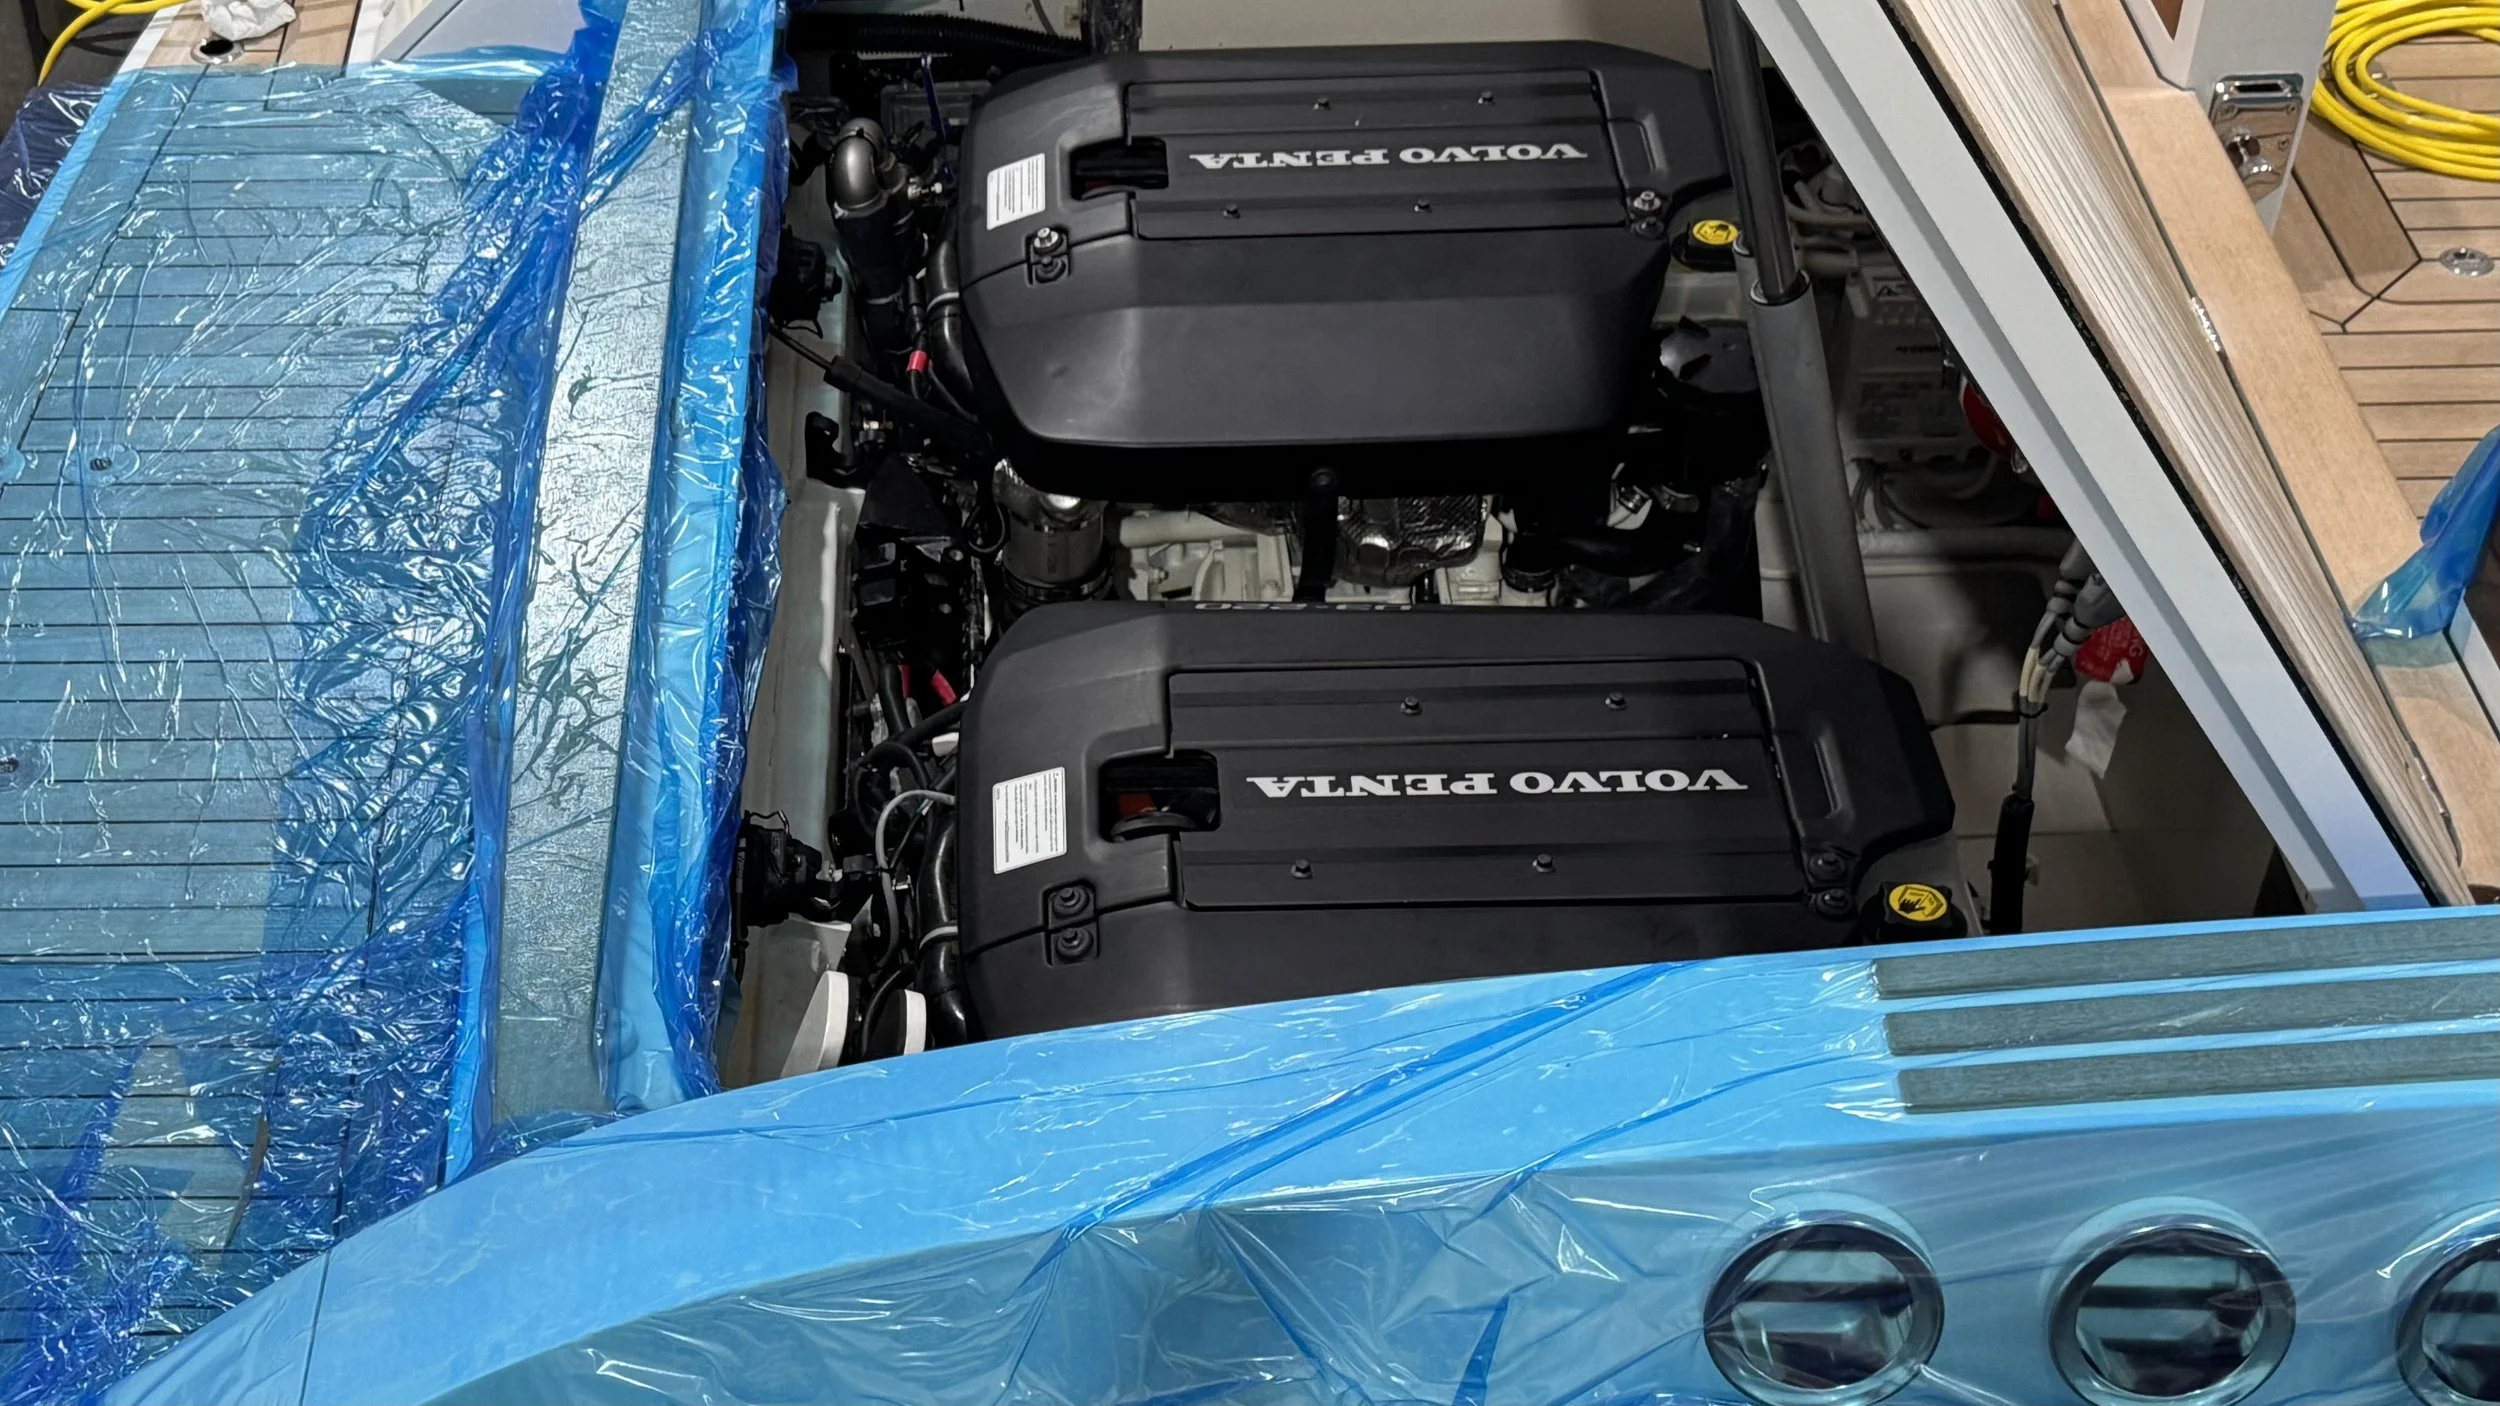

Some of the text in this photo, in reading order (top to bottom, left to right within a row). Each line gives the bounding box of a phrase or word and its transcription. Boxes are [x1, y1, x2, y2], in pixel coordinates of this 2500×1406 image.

[1189, 143, 1588, 169] VOLVO PENTA
[1246, 769, 1748, 798] VOLVO PENTA
